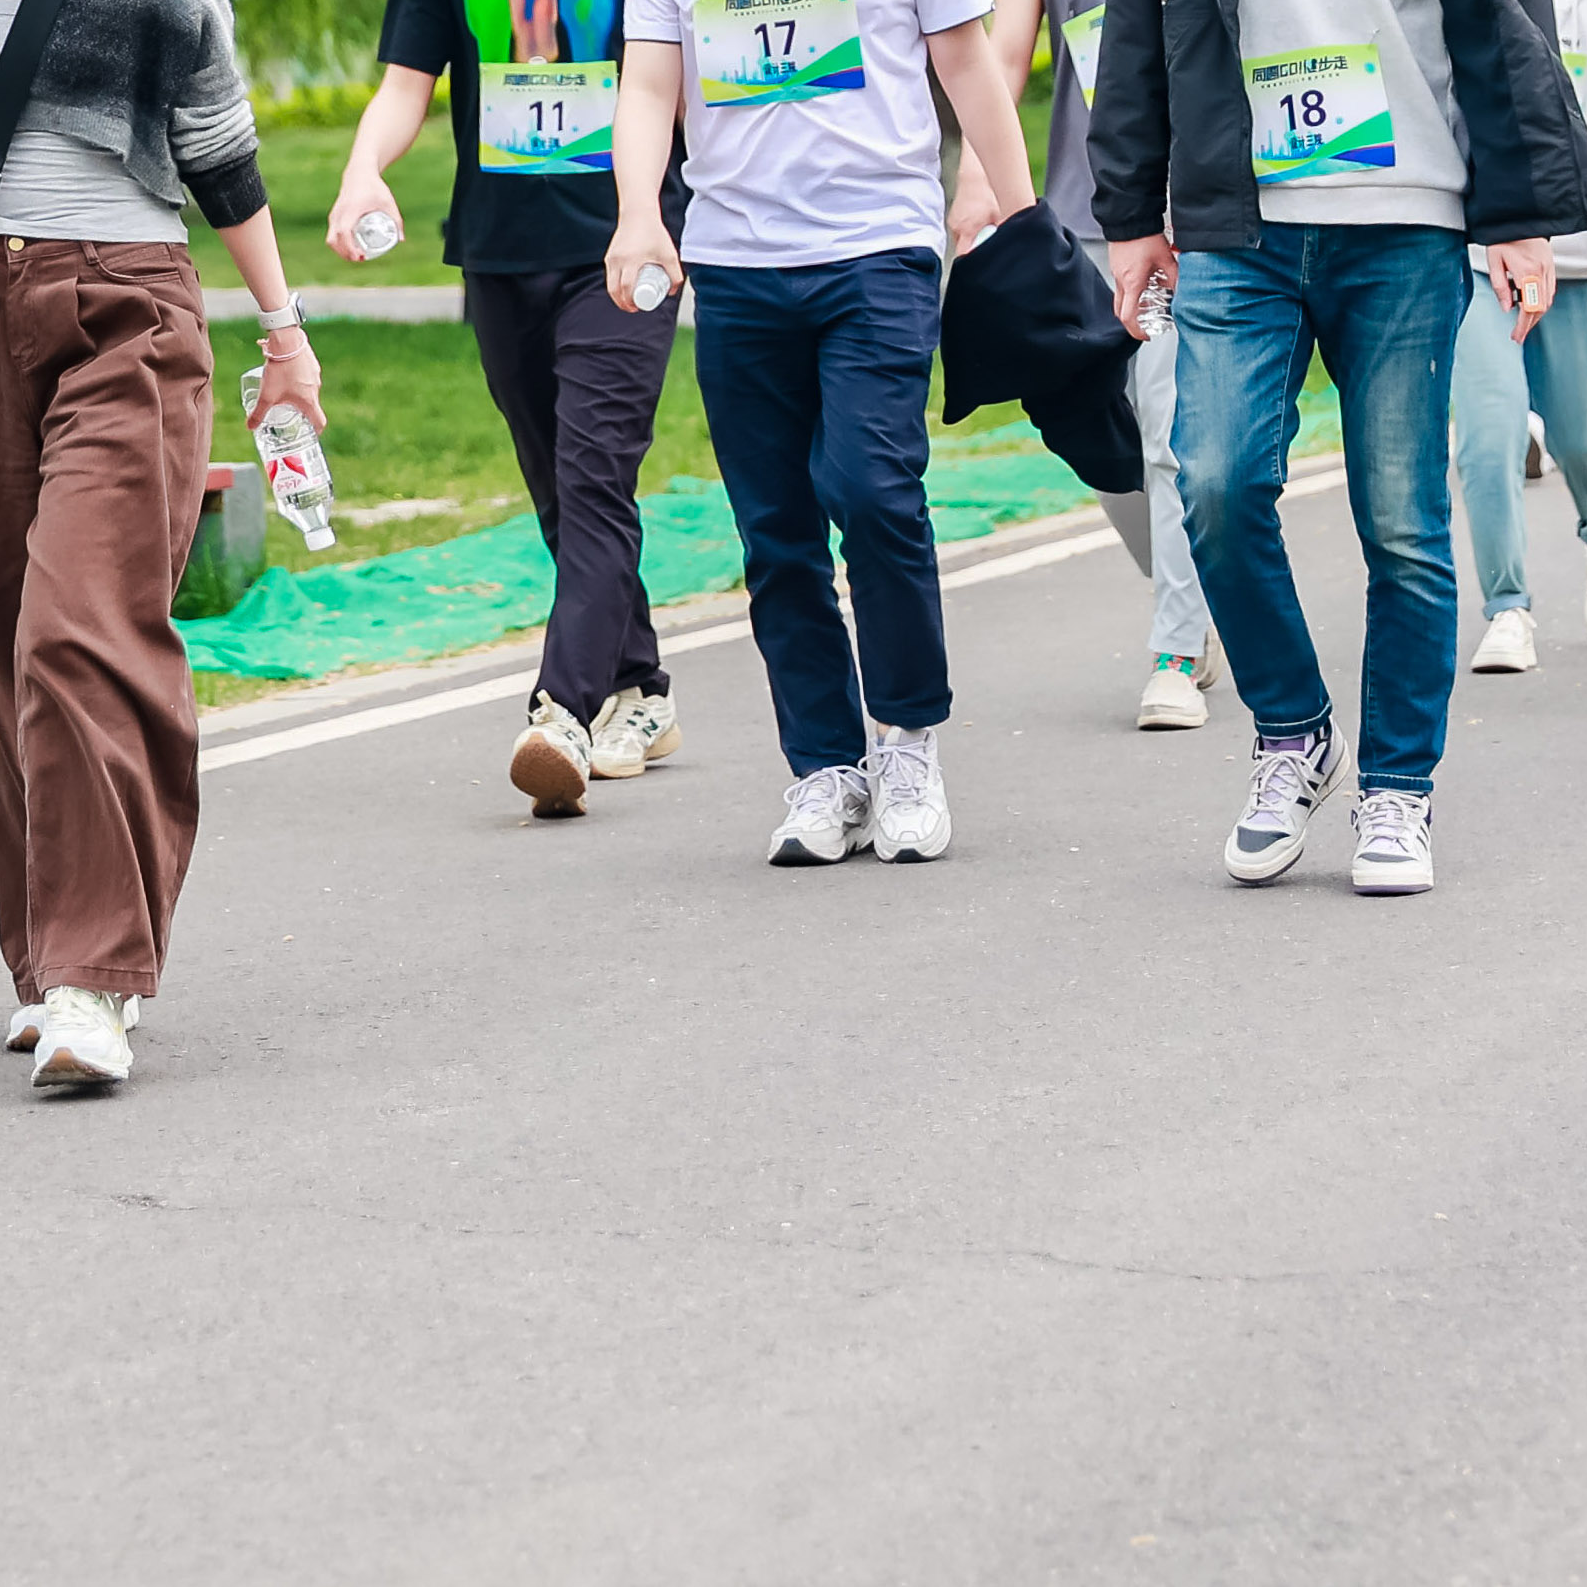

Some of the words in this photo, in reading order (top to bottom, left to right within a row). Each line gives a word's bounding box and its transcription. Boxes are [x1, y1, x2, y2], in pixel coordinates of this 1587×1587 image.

[754, 20, 796, 57] 17
[529, 100, 564, 131] 11
[1280, 89, 1326, 131] 18
